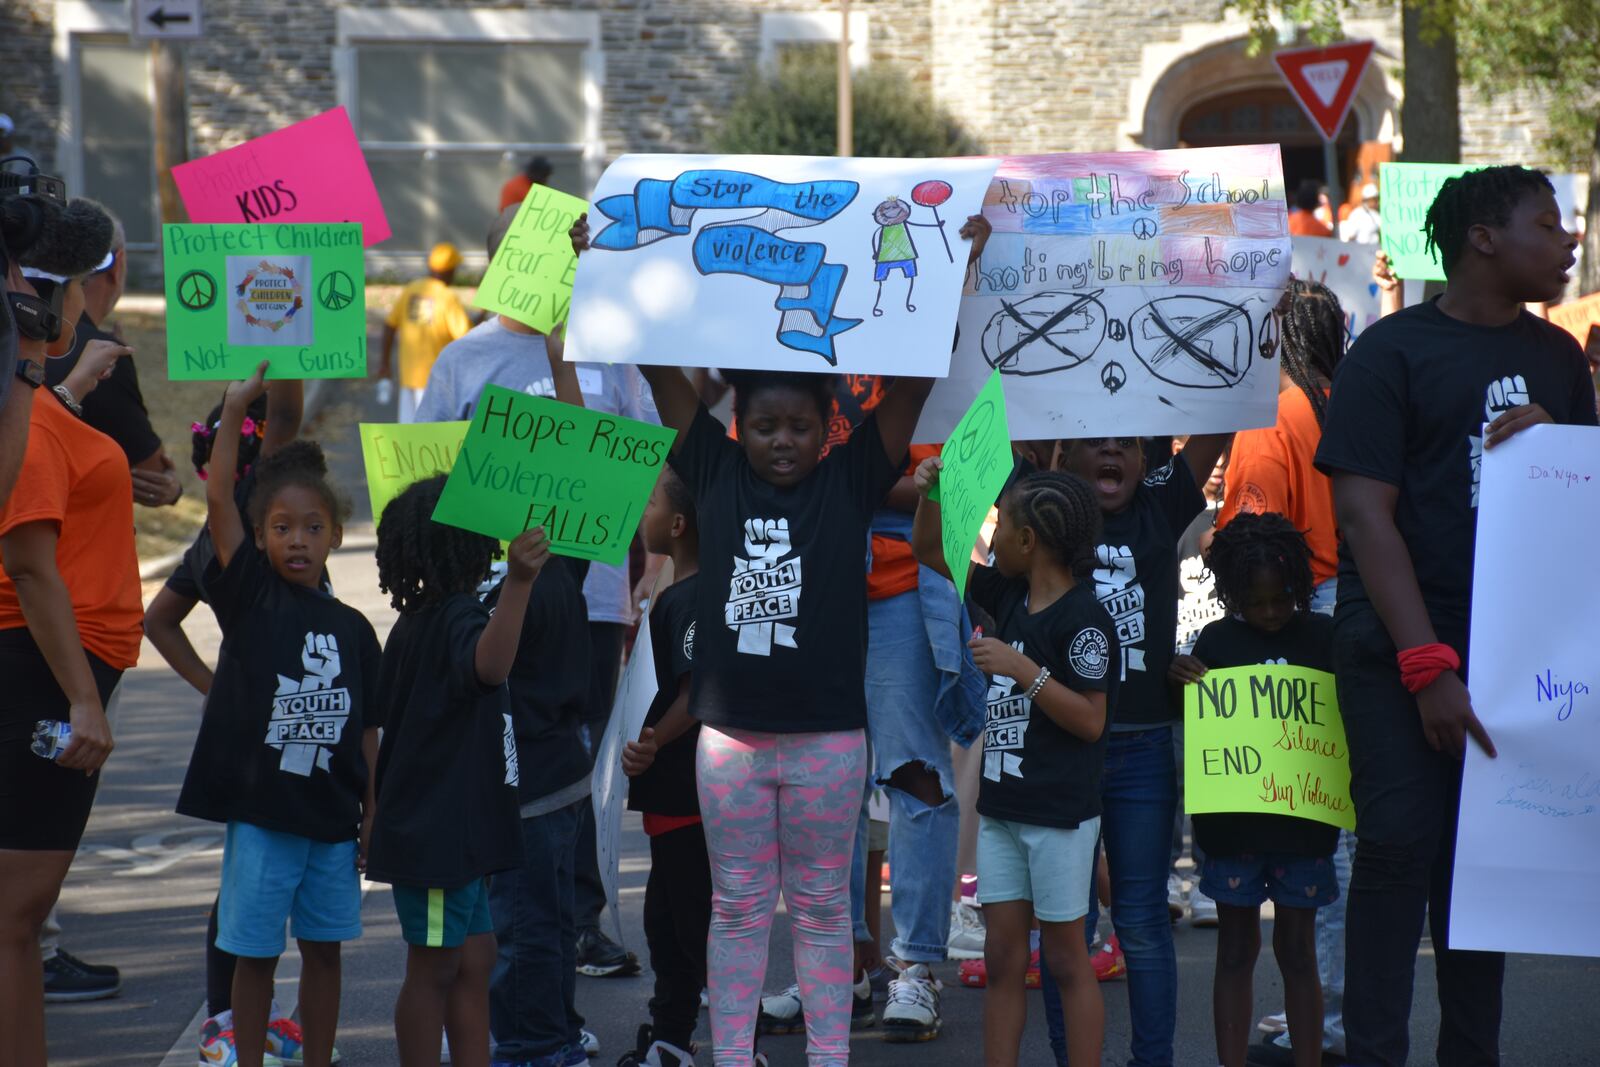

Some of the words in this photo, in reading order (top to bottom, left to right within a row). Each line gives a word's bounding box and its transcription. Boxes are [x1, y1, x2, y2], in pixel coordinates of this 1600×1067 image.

[236, 180, 297, 223] KIDS
[690, 178, 753, 203] Stop
[795, 185, 837, 209] the
[1000, 180, 1069, 223] top
[1086, 173, 1155, 219] the
[1172, 170, 1268, 211] School
[520, 191, 575, 244] Hop
[169, 224, 268, 255] Protect
[275, 223, 360, 249] Children
[713, 232, 806, 265] violence
[963, 247, 1088, 289] hooting
[1099, 240, 1183, 284] bring
[1205, 236, 1281, 280] hope
[255, 279, 287, 287] PROTECT
[498, 275, 541, 316] Gun
[184, 343, 230, 371] Not
[299, 336, 362, 372] Guns!
[481, 395, 575, 453] Hope
[589, 419, 665, 467] Rises
[374, 434, 464, 481] ENOU
[463, 447, 587, 502] Violence
[734, 564, 794, 594] YOUTH
[734, 596, 791, 620] PEACE
[1104, 590, 1140, 616] UTH
[1073, 631, 1092, 654] HOPE
[1092, 631, 1107, 655] ZONE
[280, 693, 344, 713] YOUTH
[1198, 677, 1237, 719] NO
[1249, 675, 1325, 726] MORE
[1536, 669, 1589, 721] Niya
[279, 723, 334, 739] PEACE
[1273, 720, 1345, 760] Silence
[1203, 745, 1261, 776] END
[1258, 772, 1297, 811] Gun
[1297, 773, 1349, 812] Violence
